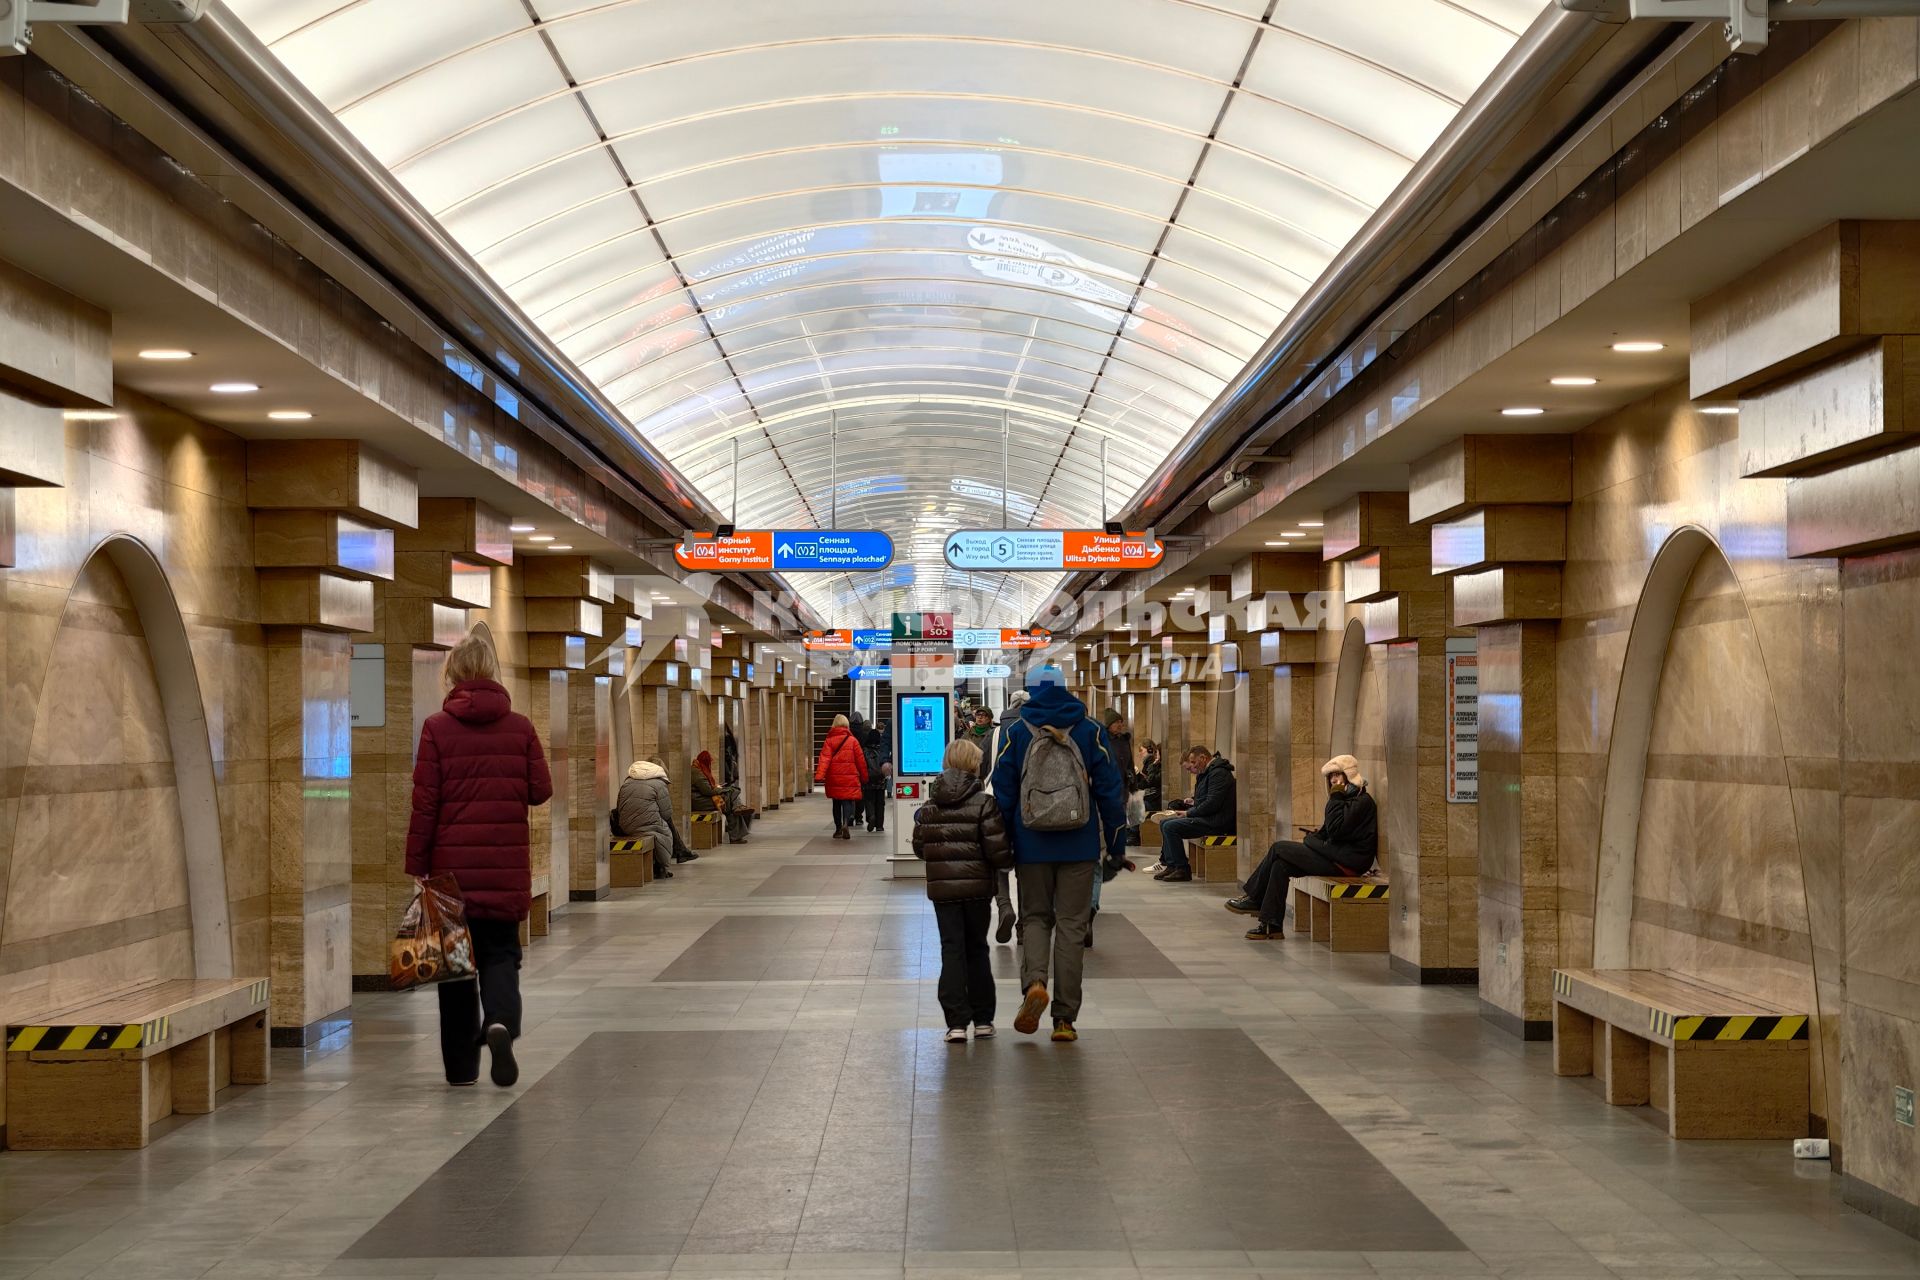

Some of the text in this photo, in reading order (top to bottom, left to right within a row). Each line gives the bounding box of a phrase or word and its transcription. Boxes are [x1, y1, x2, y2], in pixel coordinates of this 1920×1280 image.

[718, 536, 750, 546] Горный
[819, 536, 850, 544] Сенная
[966, 538, 987, 546] Выход
[1093, 536, 1120, 545] Улица
[718, 546, 756, 555] институт
[819, 546, 858, 555] площадь
[972, 546, 990, 554] город
[998, 544, 1007, 556] 5
[1082, 545, 1120, 555] Дыбенко
[718, 556, 742, 565] Gorny
[819, 555, 887, 564] Sennaya ploschad'
[1088, 555, 1120, 564] Dybenko
